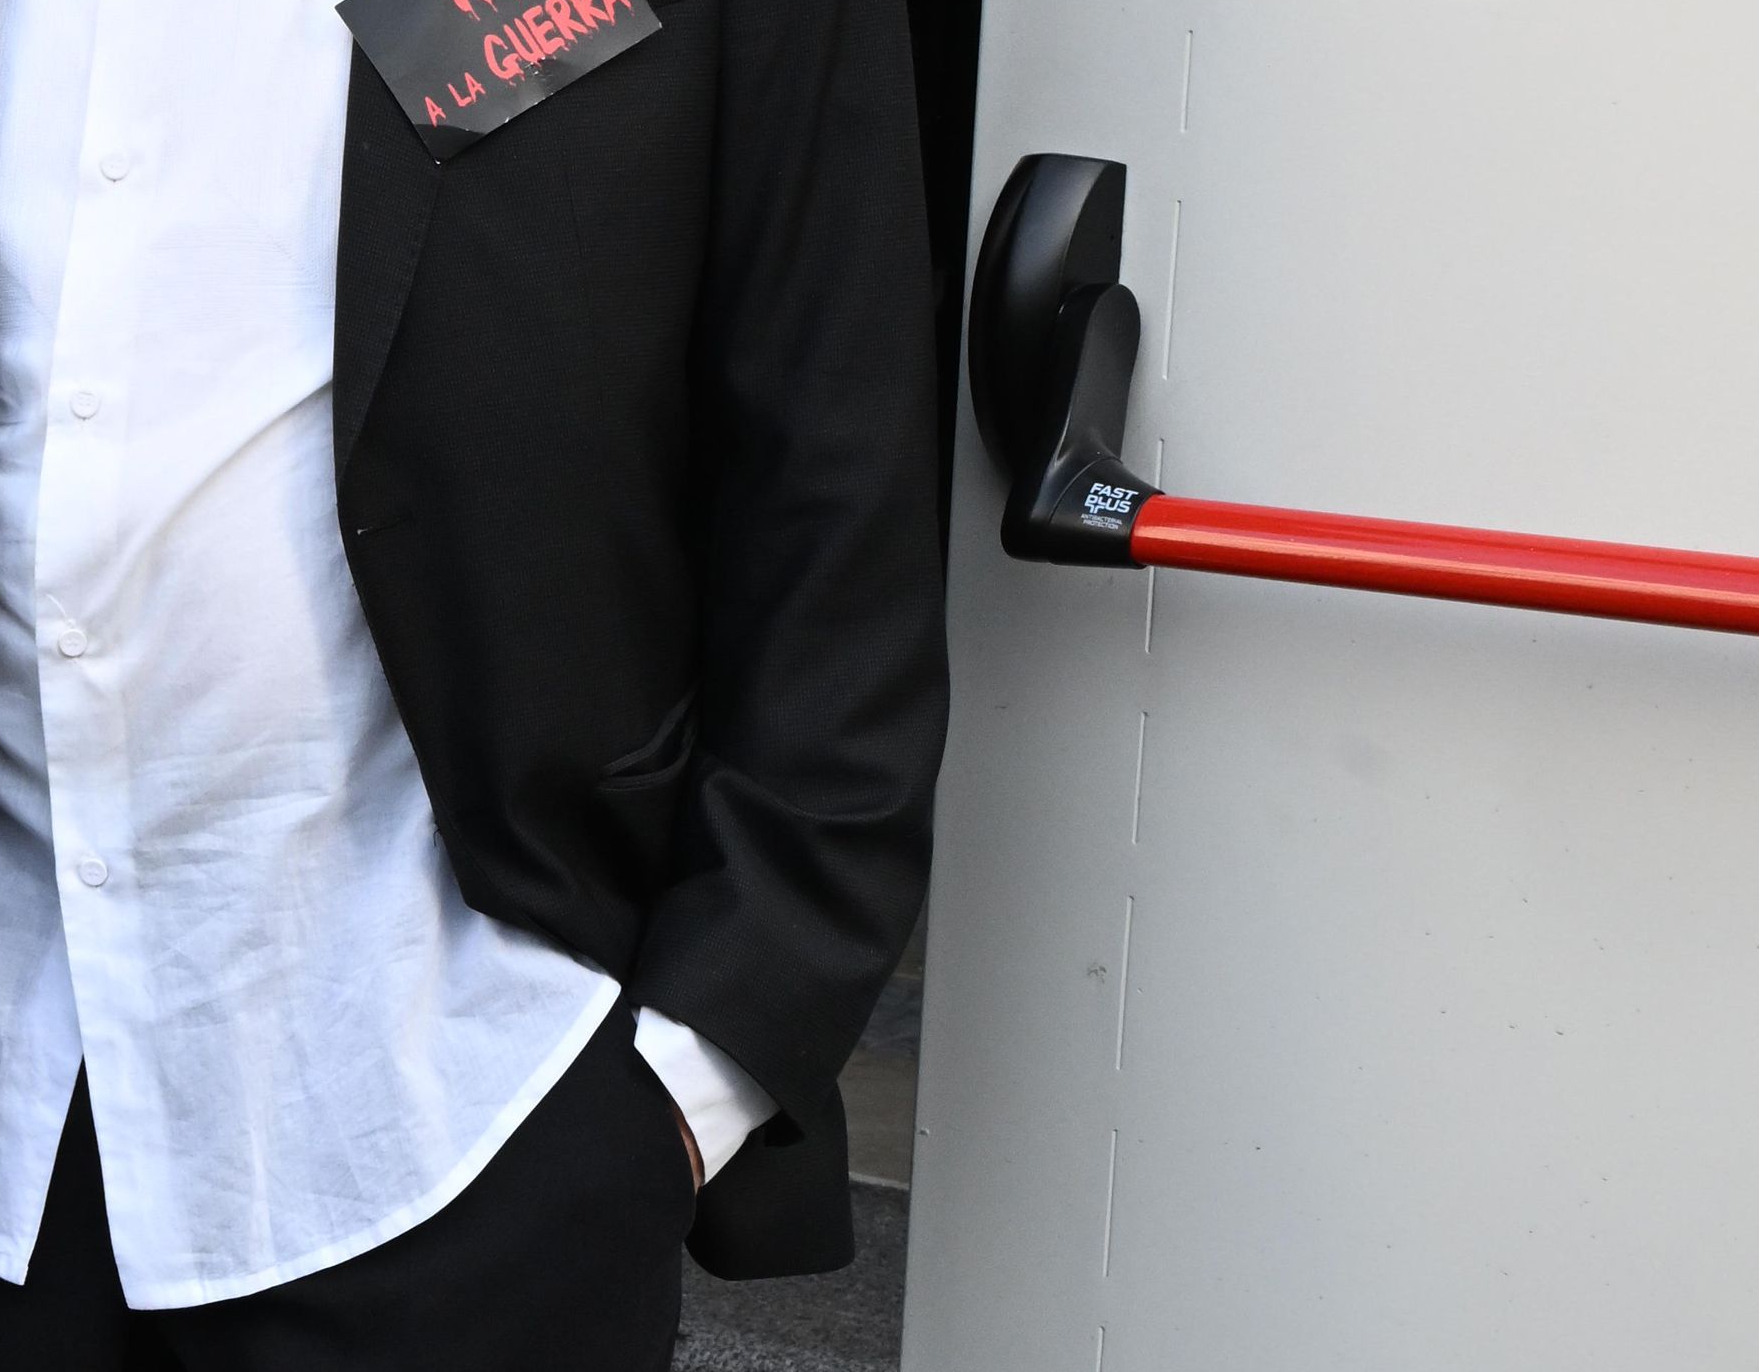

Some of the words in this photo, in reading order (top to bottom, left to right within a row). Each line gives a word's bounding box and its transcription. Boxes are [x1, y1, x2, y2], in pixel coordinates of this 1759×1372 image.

[424, 96, 447, 127] A
[447, 72, 487, 107] LA
[1090, 482, 1139, 501] FAST
[1084, 494, 1132, 514] PLUS
